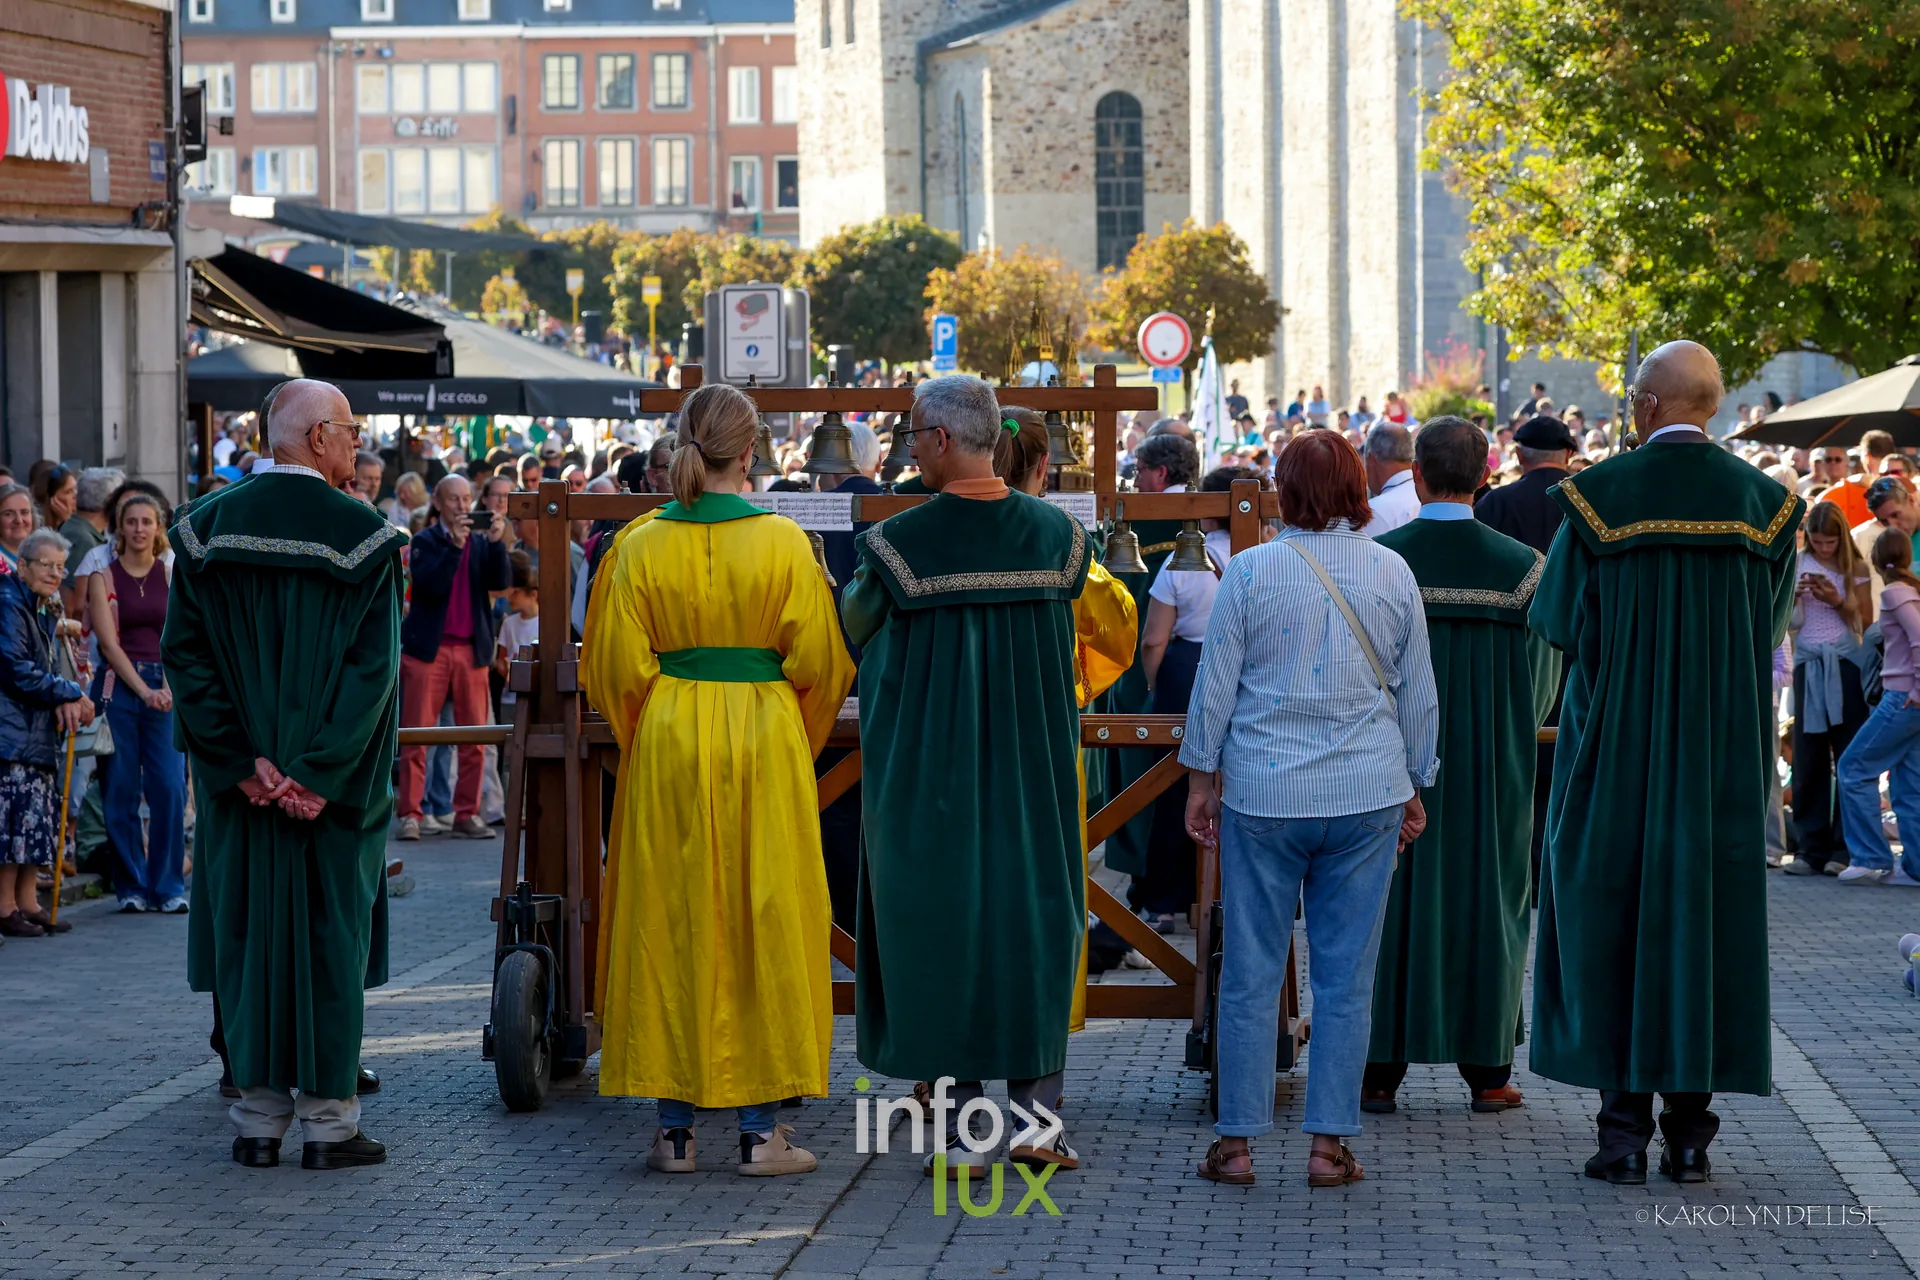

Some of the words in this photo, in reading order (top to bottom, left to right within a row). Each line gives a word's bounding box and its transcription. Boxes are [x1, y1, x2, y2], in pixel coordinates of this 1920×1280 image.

[937, 321, 954, 352] P
[377, 391, 396, 402] We
[396, 393, 425, 402] serve
[437, 392, 455, 403] ICE
[456, 393, 488, 404] COLD
